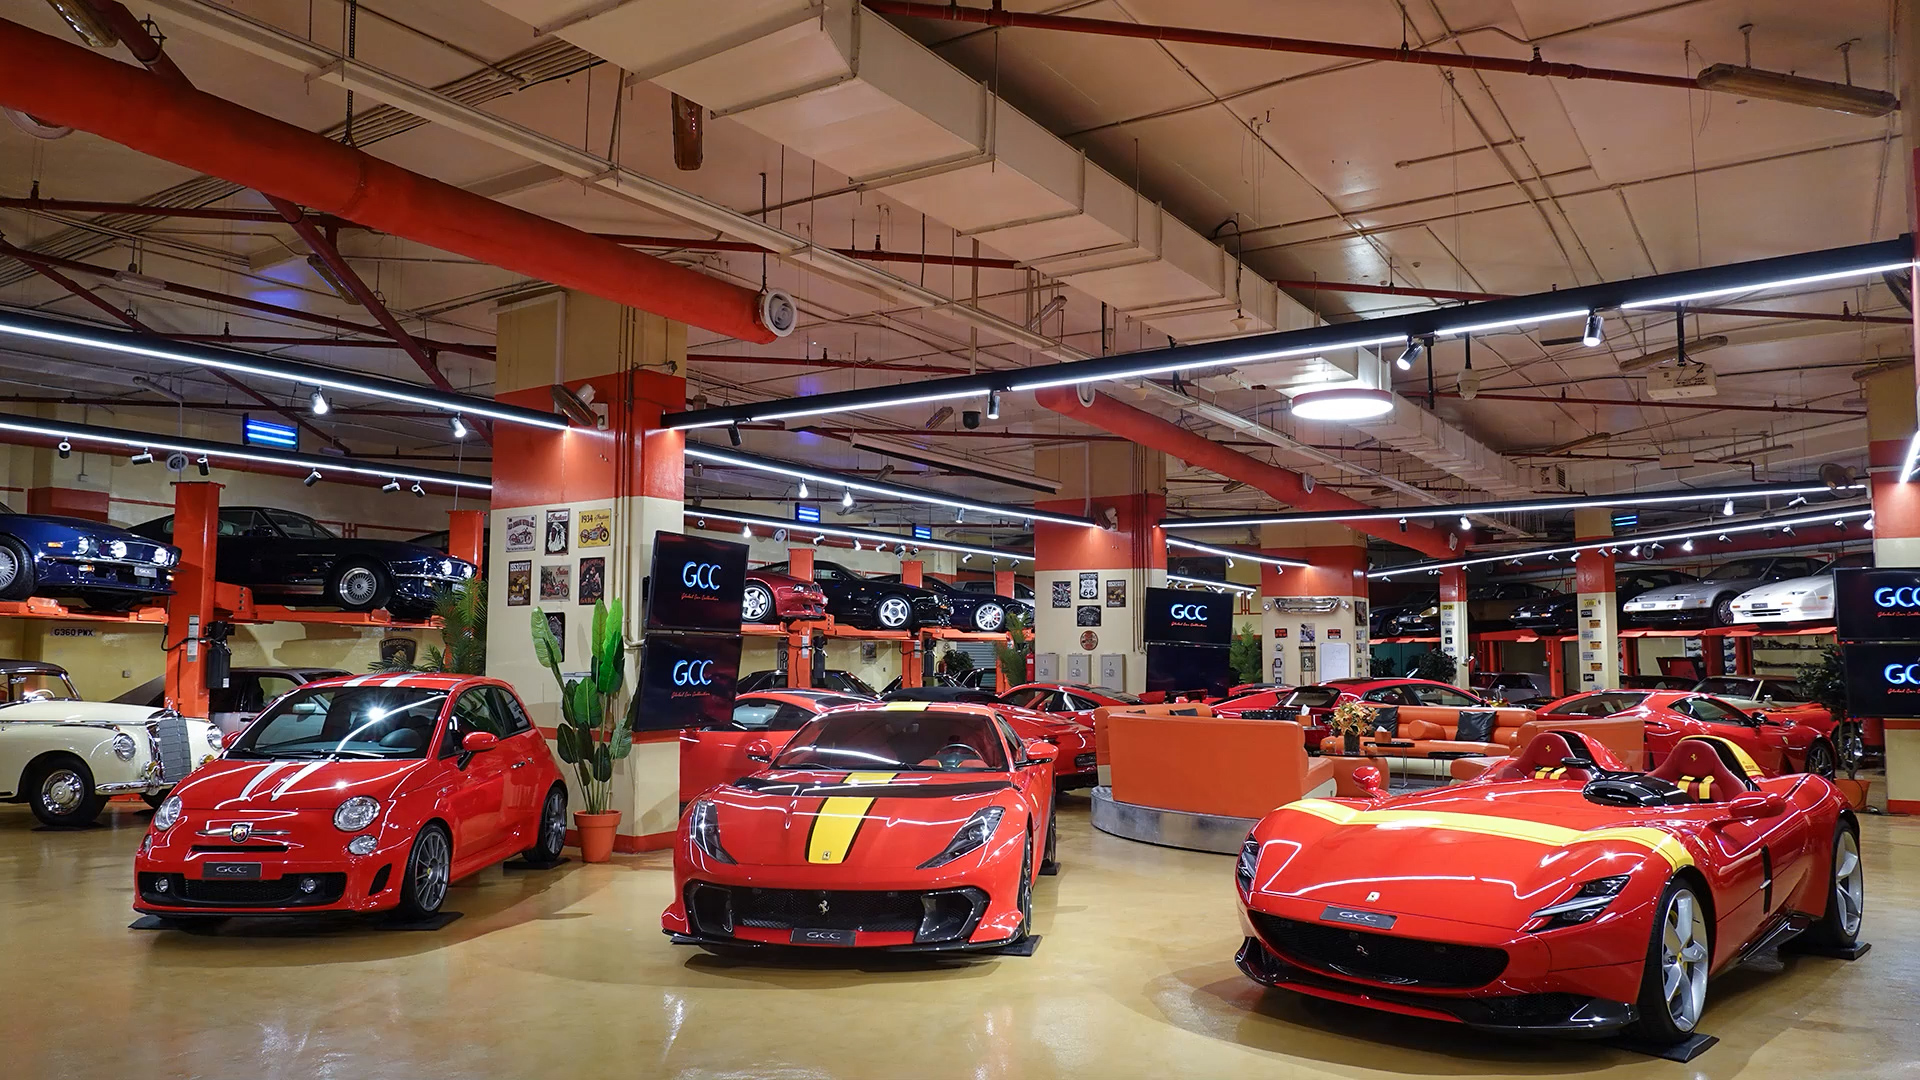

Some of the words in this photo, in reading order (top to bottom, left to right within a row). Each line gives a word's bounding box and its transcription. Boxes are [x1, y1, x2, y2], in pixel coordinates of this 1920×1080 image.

[581, 514, 593, 523] 1934
[682, 561, 721, 590] GCC
[1083, 588, 1094, 596] 66
[1171, 604, 1208, 621] GCC
[673, 660, 714, 686] GCC
[1339, 911, 1378, 922] GCC
[806, 931, 841, 939] GCC
